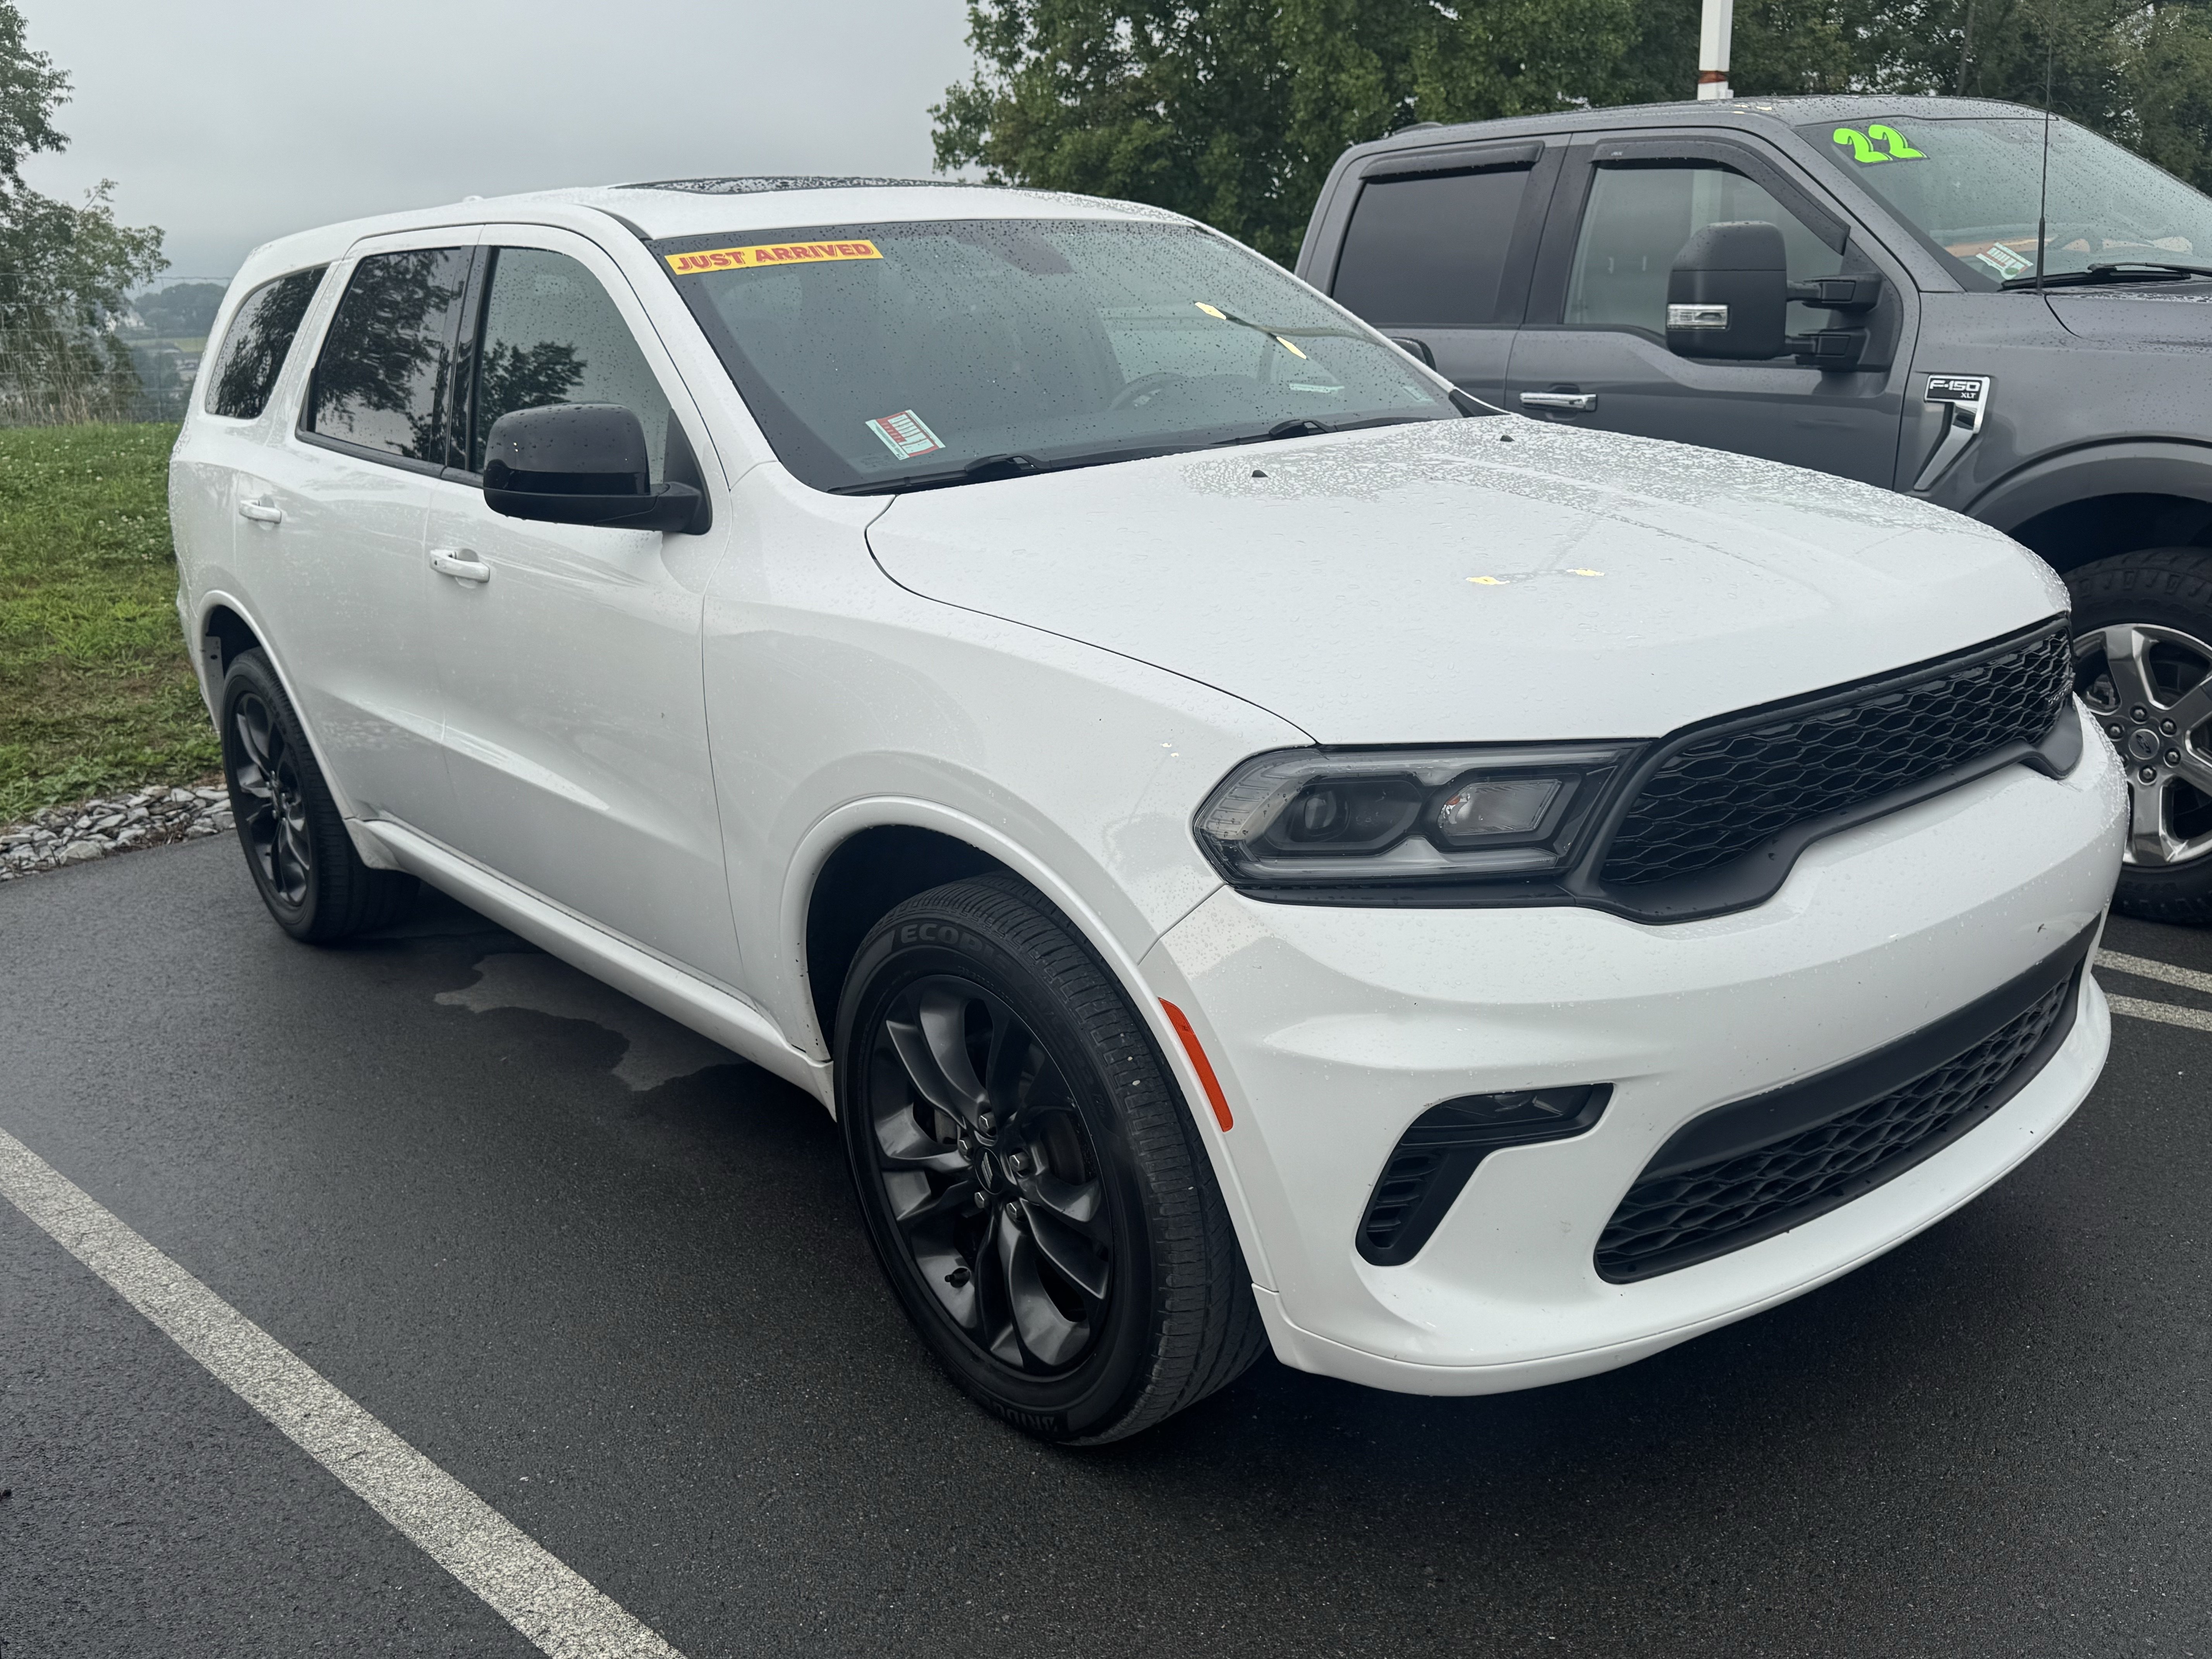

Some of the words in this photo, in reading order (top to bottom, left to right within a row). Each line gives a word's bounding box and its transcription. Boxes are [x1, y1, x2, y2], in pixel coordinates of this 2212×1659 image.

[1832, 124, 1928, 163] 22
[677, 251, 745, 271] JUST
[756, 239, 874, 263] ARRIVED
[1929, 379, 1981, 392] F-150
